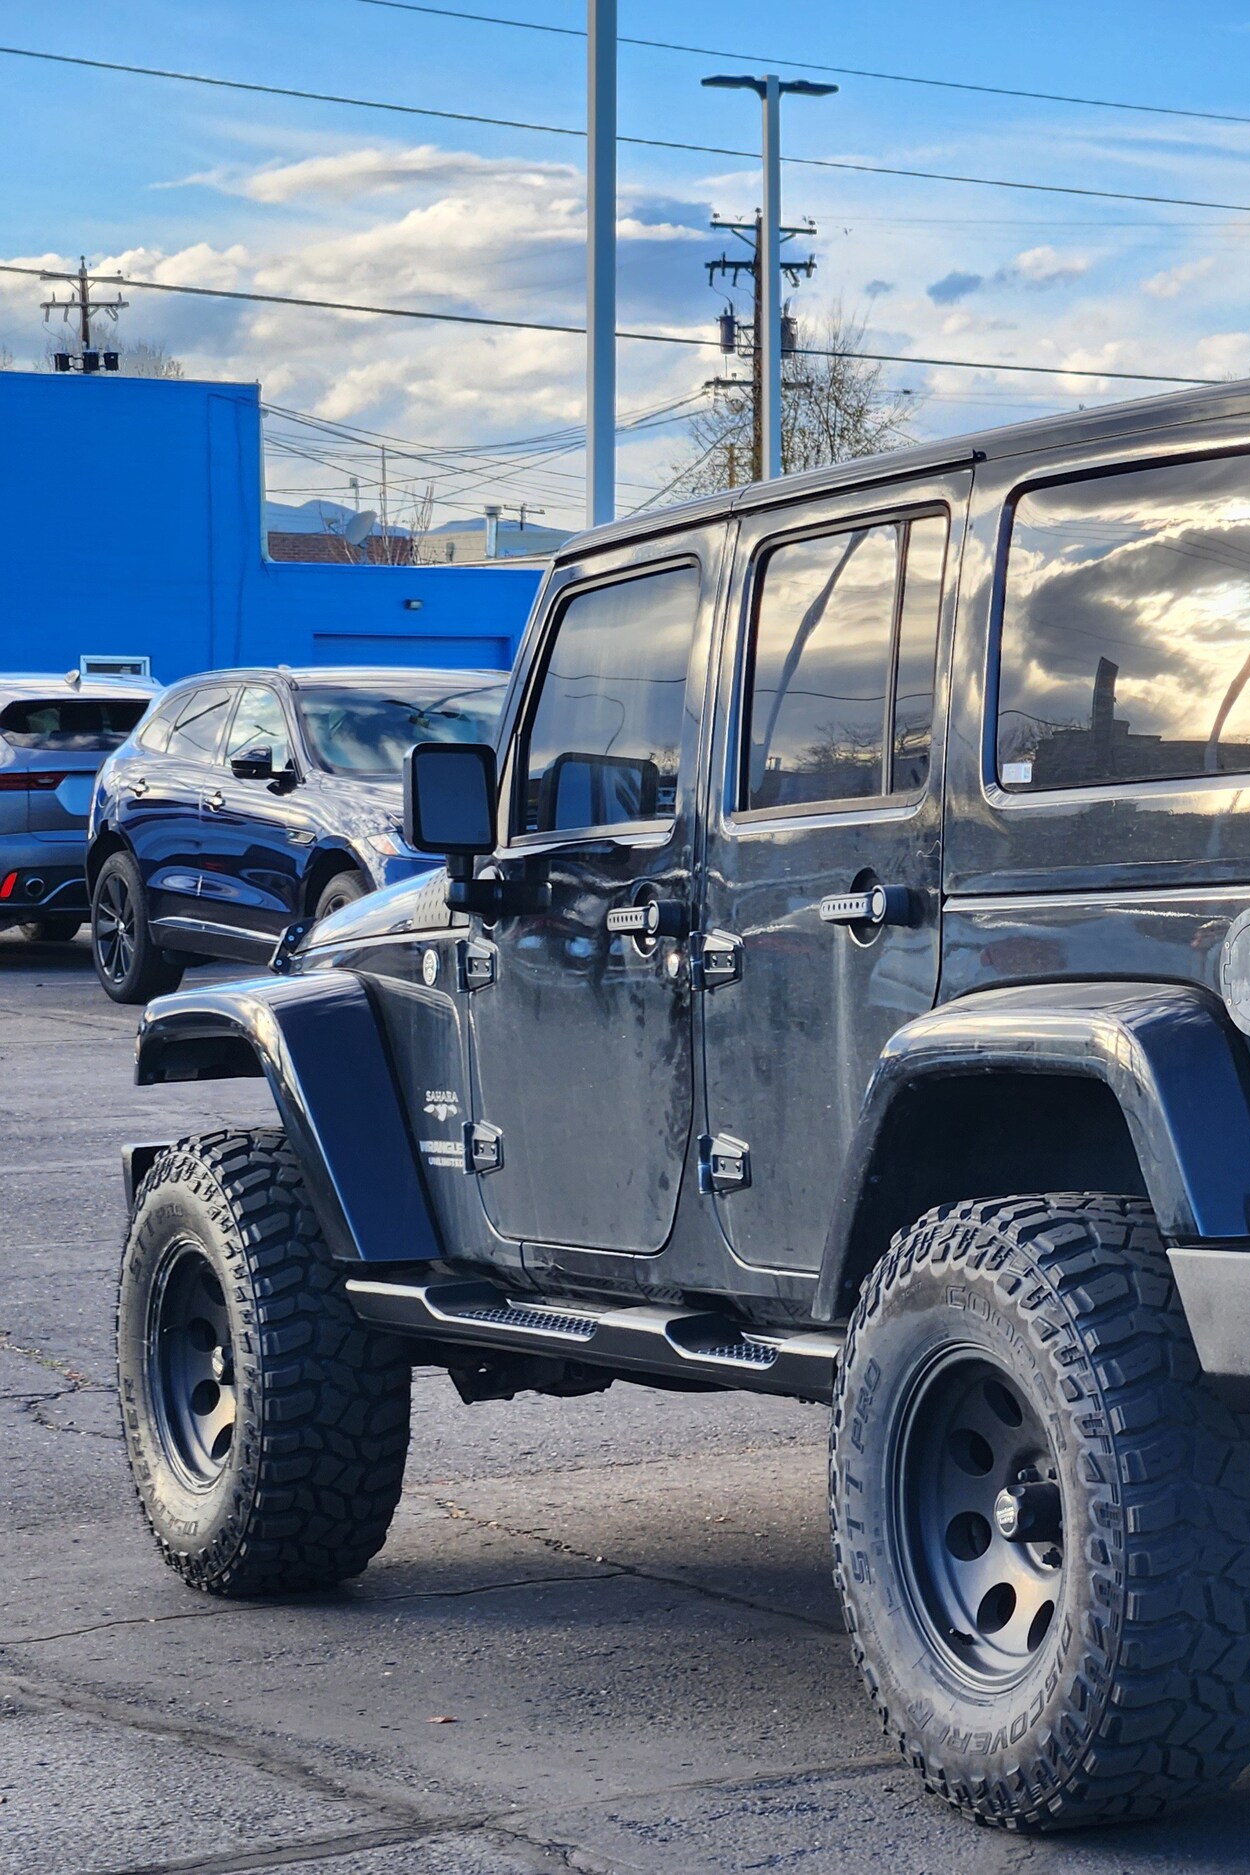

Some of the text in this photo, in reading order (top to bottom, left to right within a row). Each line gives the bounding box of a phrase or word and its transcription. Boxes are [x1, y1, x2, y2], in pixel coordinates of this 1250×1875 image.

[425, 1090, 459, 1103] SAHARA
[419, 1140, 466, 1155] WRANGLE
[945, 1284, 1067, 1453] COOPER
[845, 1357, 881, 1585] STT PRO
